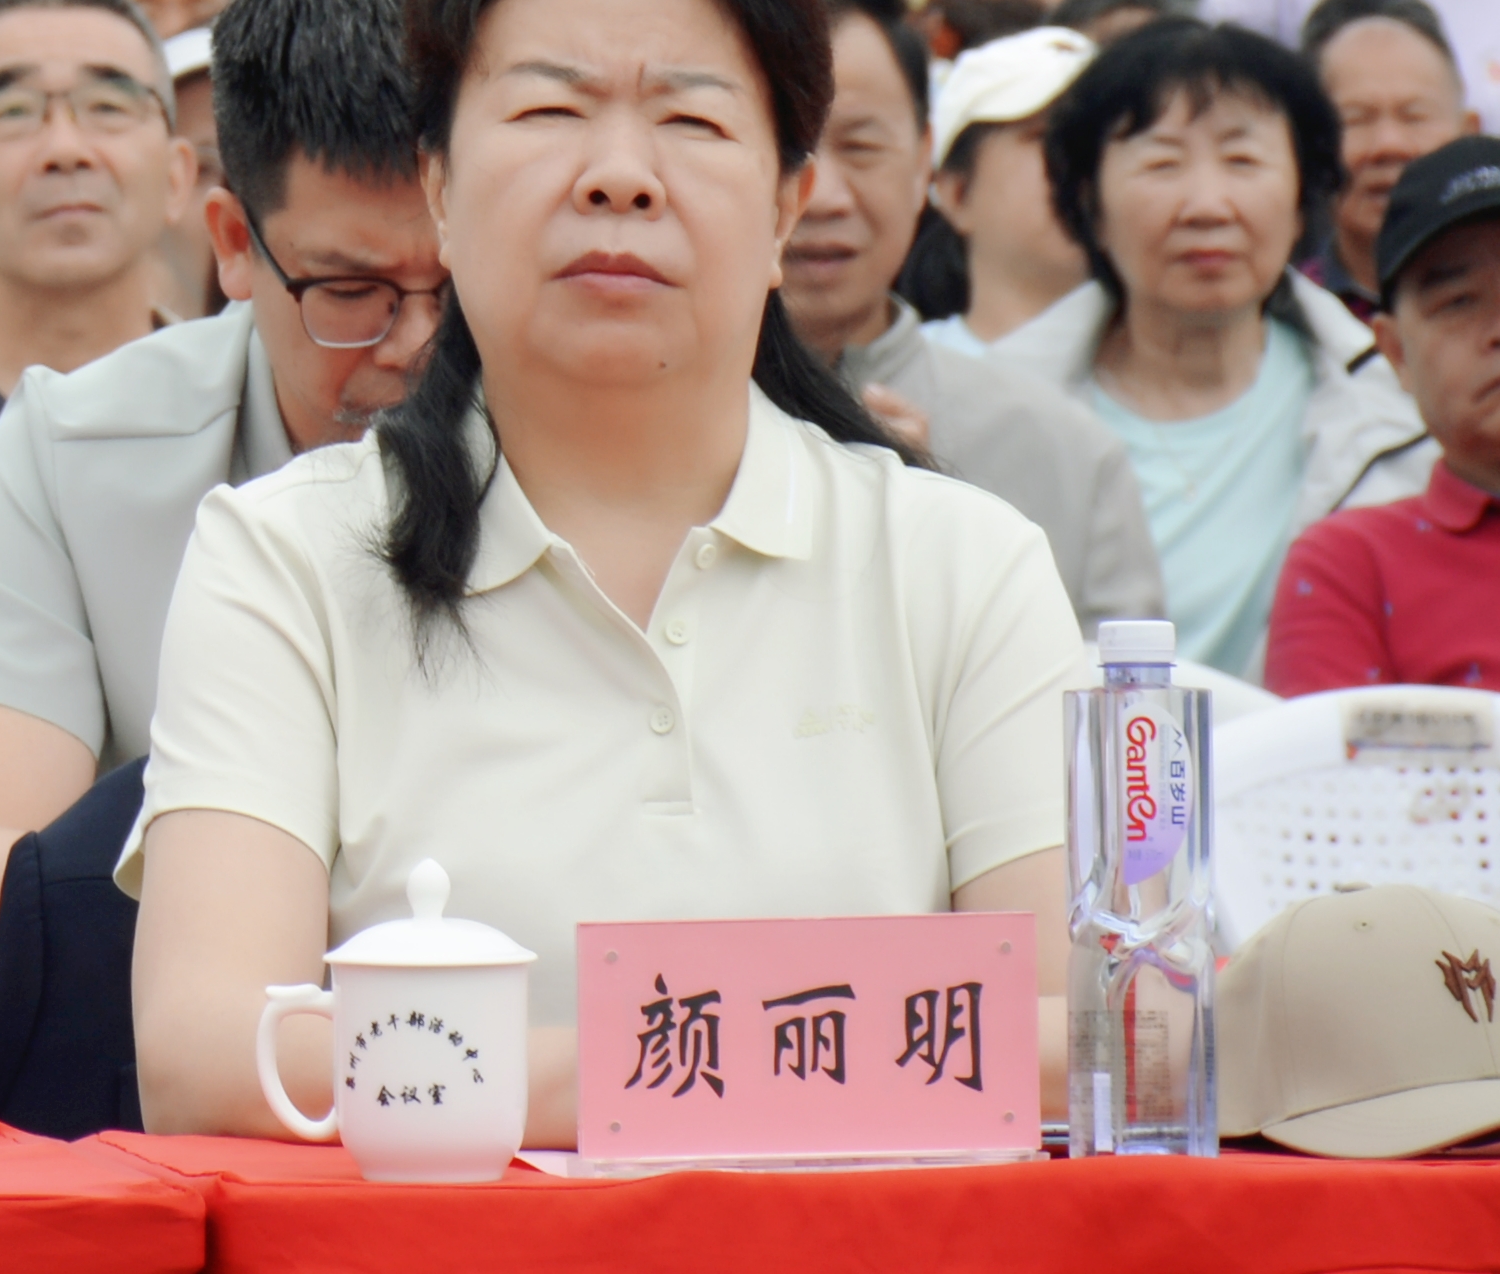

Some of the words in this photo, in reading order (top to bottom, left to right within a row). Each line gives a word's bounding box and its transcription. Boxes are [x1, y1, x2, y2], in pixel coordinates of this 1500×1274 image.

[1126, 715, 1157, 842] Ganten
[1170, 760, 1187, 825] 百岁山
[624, 973, 984, 1099] 颜丽明
[376, 1083, 447, 1108] 会议室
